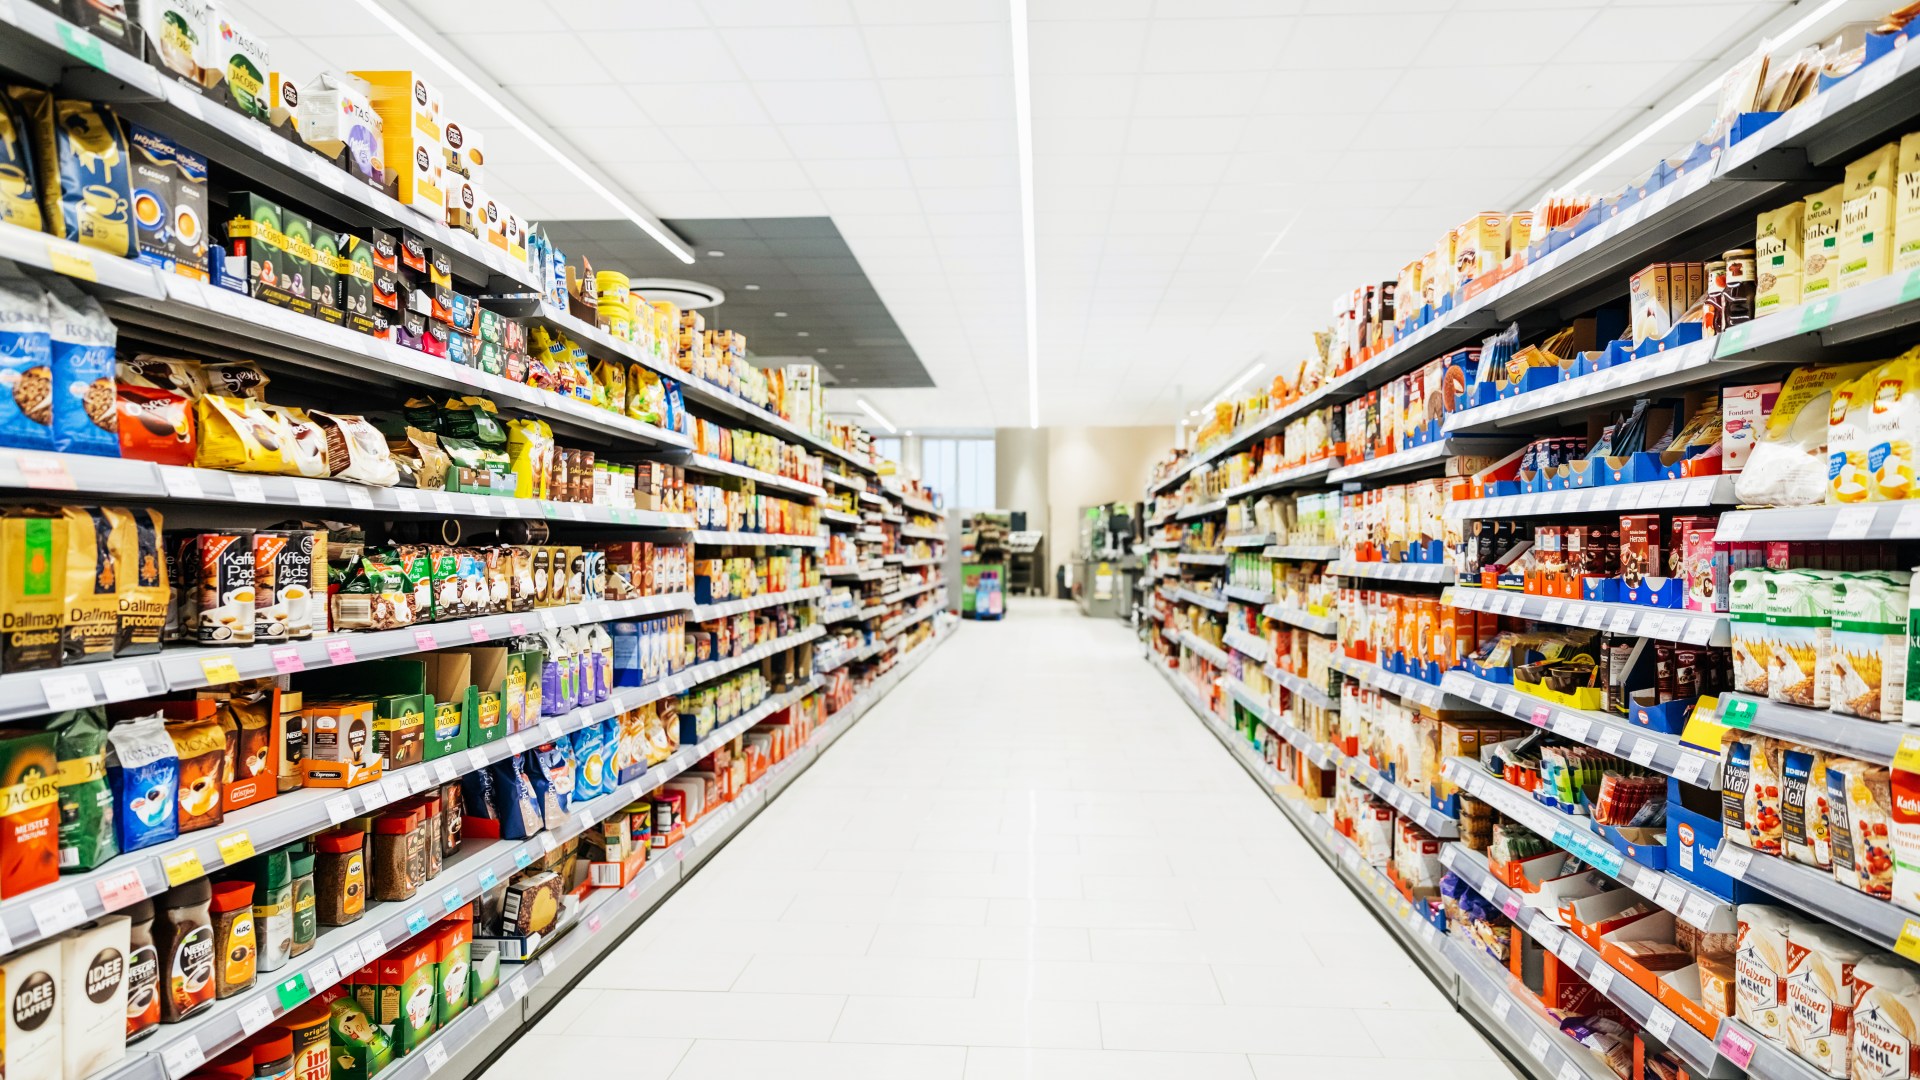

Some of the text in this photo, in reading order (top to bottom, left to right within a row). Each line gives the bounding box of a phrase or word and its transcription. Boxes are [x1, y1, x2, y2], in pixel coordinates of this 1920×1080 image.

[233, 31, 269, 66] TASSIMO
[231, 70, 258, 93] JACOBS
[354, 105, 384, 133] TASMO
[254, 225, 281, 244] JACOBS
[285, 240, 311, 257] JACOBS
[1757, 239, 1787, 258] inkel
[315, 253, 339, 269] JACOBS
[351, 267, 373, 279] JACOBS
[1820, 372, 1837, 380] Free
[224, 552, 255, 565] Kaffe
[279, 553, 310, 565] Kffee
[71, 608, 117, 622] Dallma
[11, 632, 60, 647] Classic
[71, 625, 117, 640] prodom
[508, 676, 524, 685] JACOBS
[481, 705, 498, 713] JACOBS
[400, 717, 419, 728] JACOBS
[437, 717, 456, 728] JACOBS
[178, 737, 218, 752] MONA
[1786, 767, 1807, 777] EDEKA
[1724, 774, 1749, 793] Mehl
[2, 781, 58, 811] JACOBS
[1829, 798, 1846, 810] eizen
[88, 958, 122, 984] IDEE
[1737, 959, 1773, 988] Weizen
[88, 973, 120, 995] KAFFEE
[1561, 986, 1574, 1000] GUT
[1740, 975, 1766, 997] MEHL
[16, 980, 52, 1011] IDEE
[1789, 984, 1826, 1013] Weizen
[16, 997, 52, 1022] KAFFEE
[1795, 1002, 1818, 1025] MEHL
[1856, 1022, 1903, 1055] Weizen
[307, 1047, 328, 1068] im
[1861, 1041, 1892, 1068] MEHL
